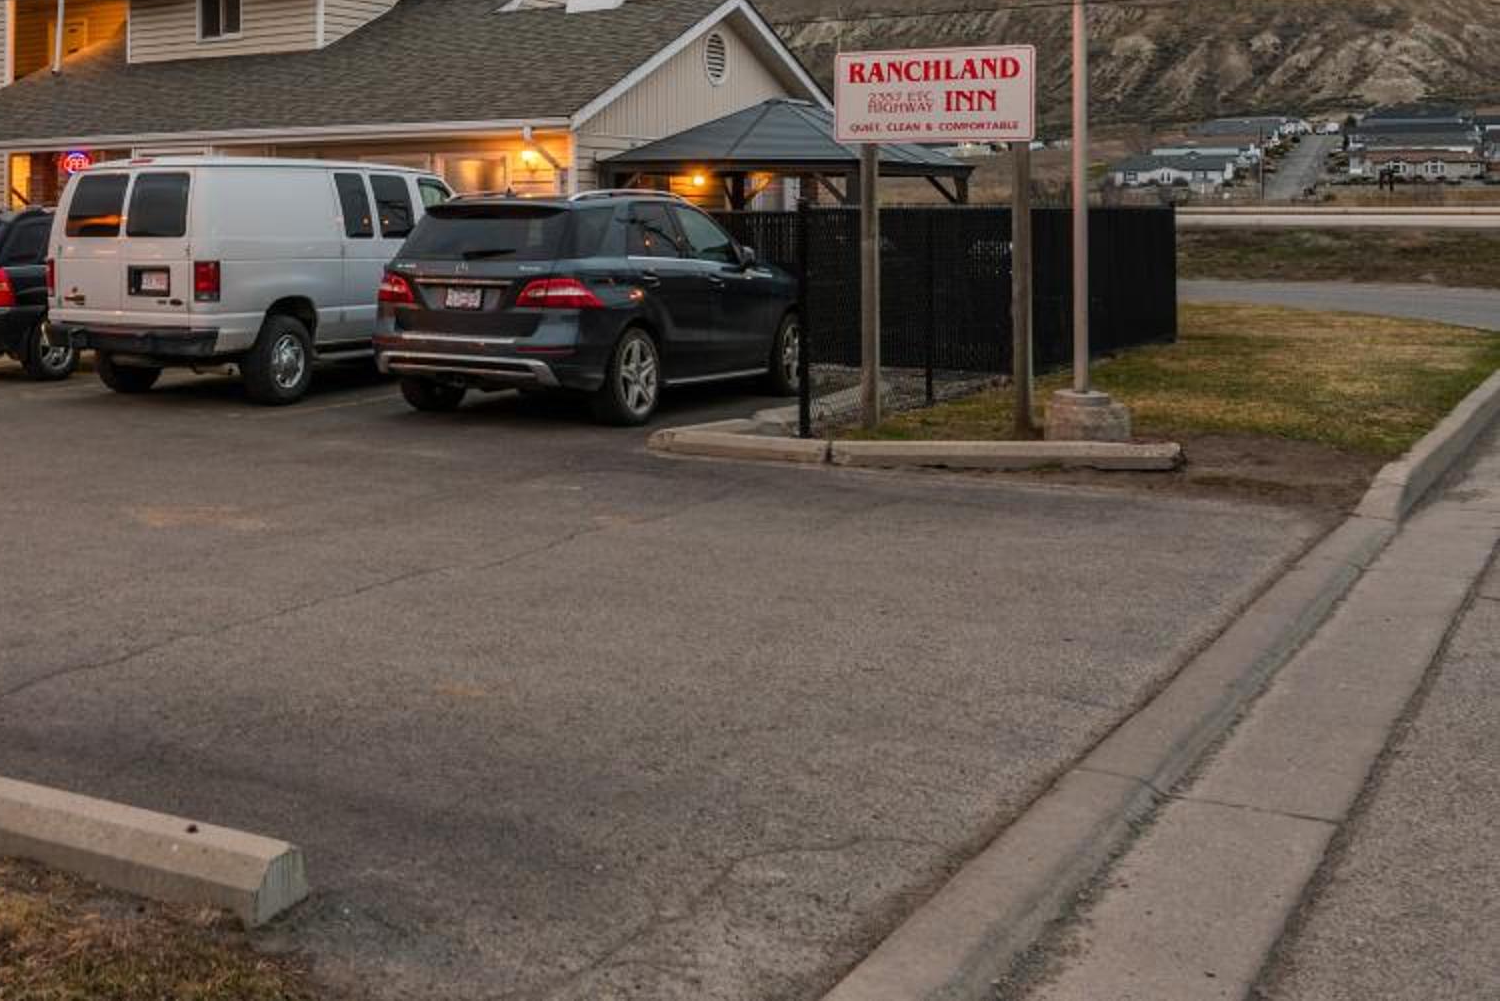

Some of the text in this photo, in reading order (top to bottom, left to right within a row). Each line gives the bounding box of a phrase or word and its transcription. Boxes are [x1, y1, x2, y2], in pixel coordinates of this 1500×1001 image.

[849, 57, 1021, 84] RANCHLAND
[944, 89, 997, 112] INN
[887, 122, 921, 132] CLEAN
[938, 120, 1019, 132] COMFORTABLE
